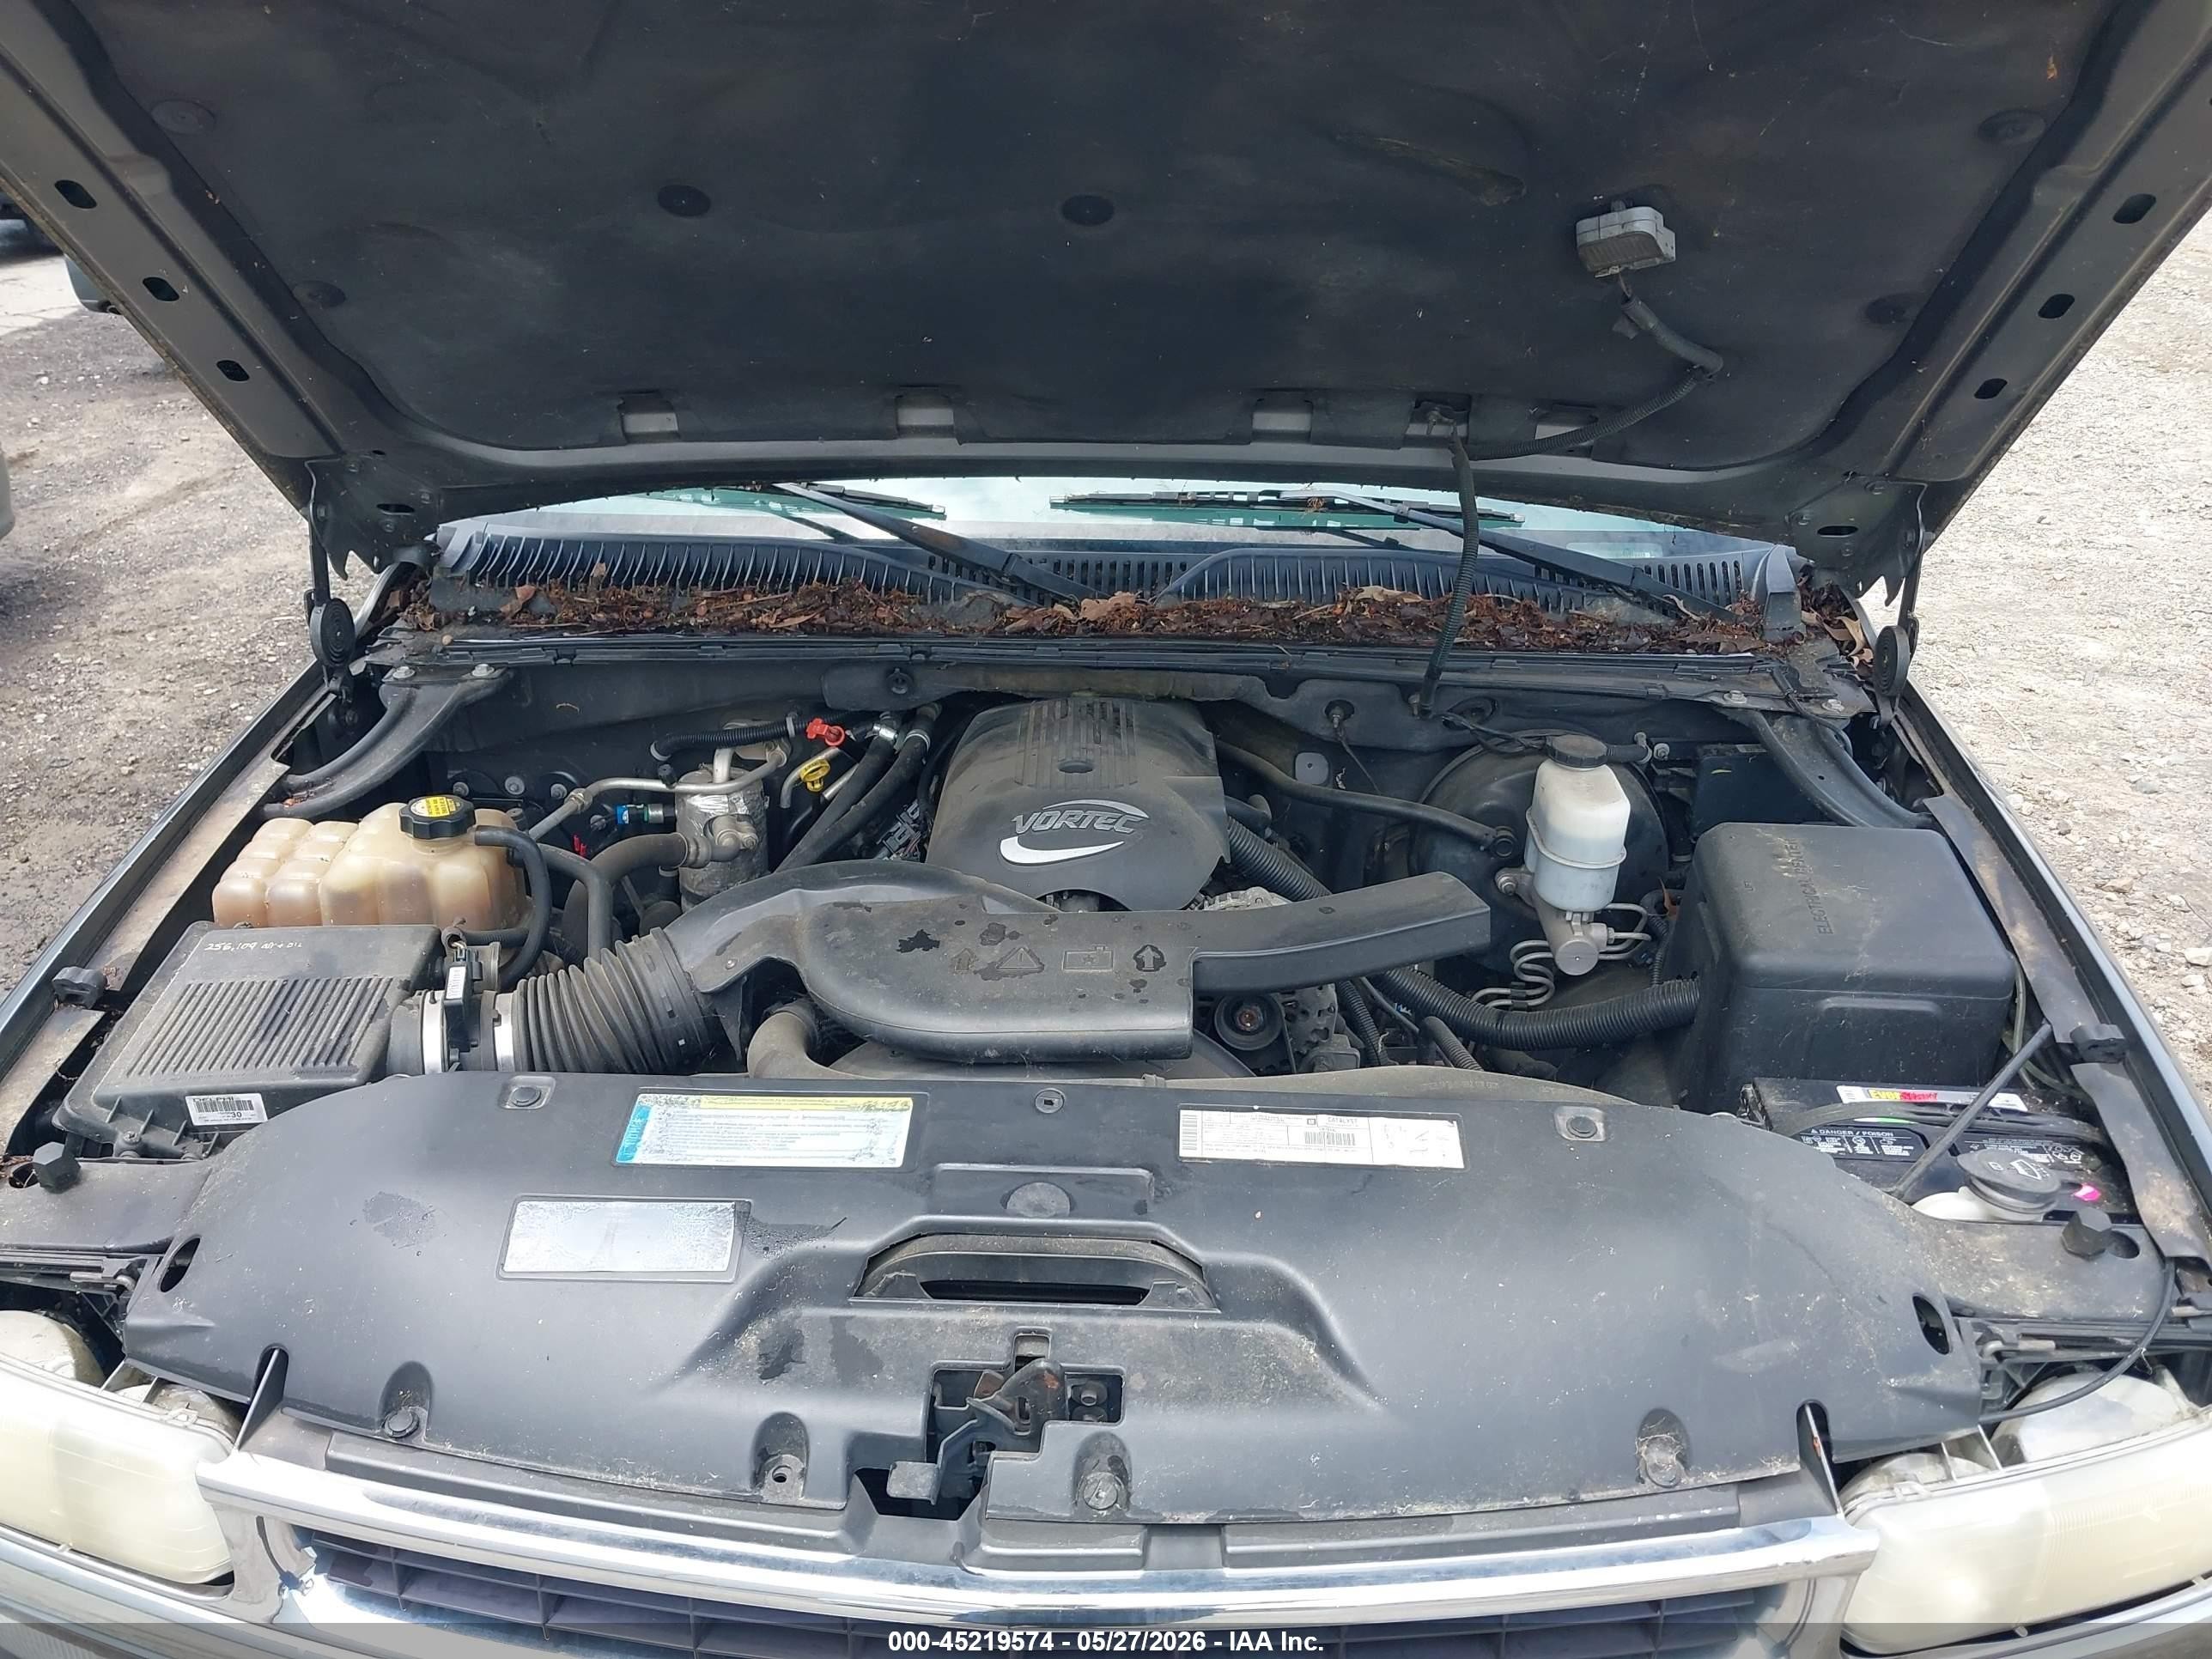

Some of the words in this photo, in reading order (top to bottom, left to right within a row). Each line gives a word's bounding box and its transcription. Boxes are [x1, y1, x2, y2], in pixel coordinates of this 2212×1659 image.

[1011, 808, 1149, 835] VORTEC
[1785, 838, 1808, 876] CENTER
[1798, 878, 1833, 935] ELECTRICAL
